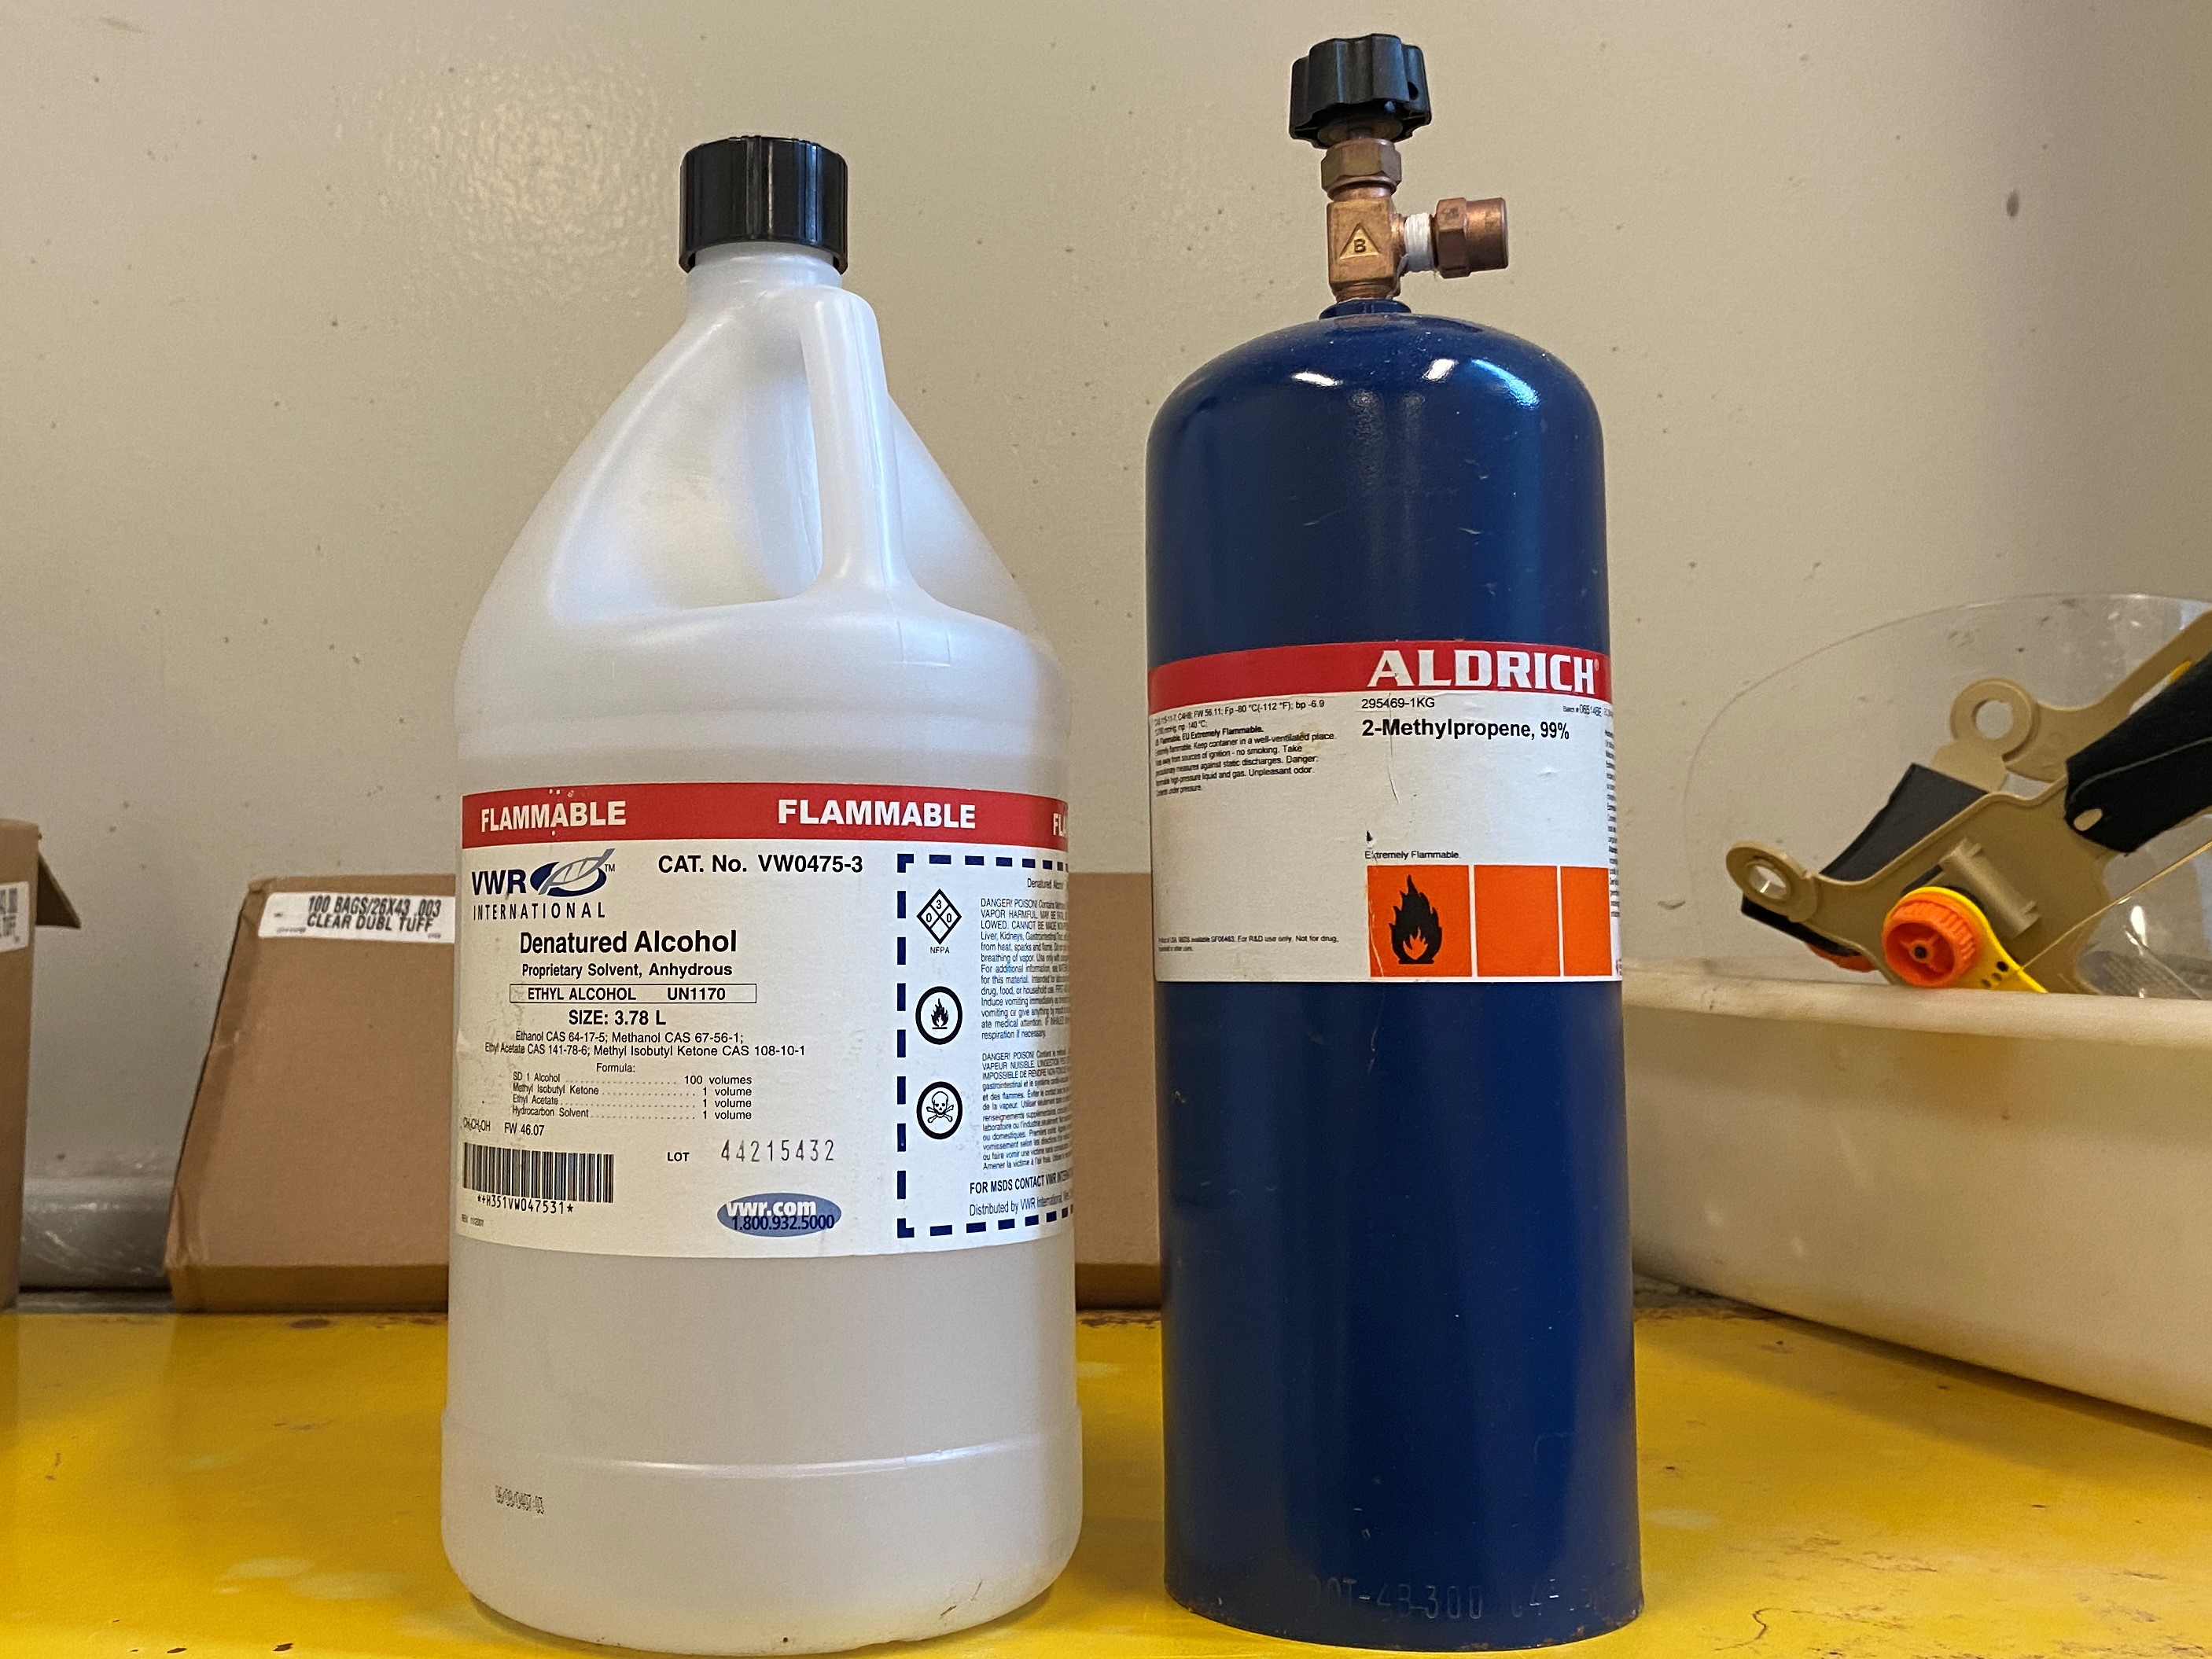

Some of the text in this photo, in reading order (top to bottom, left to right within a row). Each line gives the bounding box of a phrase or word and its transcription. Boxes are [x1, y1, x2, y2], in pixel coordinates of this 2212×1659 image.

[1354, 239, 1366, 253] B
[1367, 649, 1595, 695] ALDRICH
[1296, 701, 1306, 710] bp
[1361, 697, 1435, 708] 295469-1KG
[1191, 726, 1264, 739] Extremely Flammable.
[1362, 718, 1570, 740] 2-Methylpropene, 99%
[1194, 741, 1208, 750] Keep
[1254, 733, 1310, 744] well-ventilated
[1200, 761, 1221, 771] against
[1249, 767, 1292, 777] Unpleasant
[480, 800, 627, 833] FLAMMABLE
[778, 799, 976, 830] FLAMMABLE
[658, 855, 863, 873] CAT. No. VW0475-3
[472, 869, 527, 896] VWR
[307, 895, 331, 914] 100
[334, 896, 410, 916] BAGS/26X43
[936, 899, 942, 909] 3
[981, 899, 1013, 907] DANGER!
[473, 902, 605, 921] INTERNATIONAL
[926, 913, 951, 923] 0 0
[981, 910, 1006, 918] VAPOR
[307, 912, 434, 932] CLEAR DUBL TUFF
[1011, 921, 1036, 929] CANNOT
[520, 930, 737, 954] Denatured Alcohol
[981, 942, 996, 951] from
[1014, 943, 1032, 953] sparks
[981, 954, 1010, 964] breathing
[522, 962, 733, 979] Proprietary Solvent, Anhydrous
[981, 964, 1023, 973] For additional
[981, 975, 1003, 984] for this
[528, 988, 726, 1001] ETHYL ALCOHOL UN1170
[981, 997, 1028, 1007] Induce vomiting
[569, 1010, 666, 1025] SIZE: 3.78 L
[981, 1008, 1008, 1019] vomiting
[1018, 1008, 1029, 1017] give
[981, 1019, 1018, 1028] ate medical
[516, 1030, 744, 1044] Ethanol CAS 64-17-5; Methanol CAS 67-56-1;
[981, 1030, 1014, 1041] respiration
[500, 1043, 525, 1054] Acetate
[528, 1044, 545, 1055] CAS
[548, 1044, 590, 1057] 141-78-6;
[594, 1045, 627, 1058] Methyl
[631, 1045, 673, 1059] Isobutyl
[677, 1046, 718, 1057] Ketone
[722, 1045, 749, 1057] CAS
[754, 1045, 805, 1057] 108-10-1
[596, 1062, 635, 1073] Formula:
[513, 1072, 753, 1085] SD 1 Alcohol 100 volumes
[982, 1071, 1018, 1080] IMPOSSIBLE
[513, 1083, 753, 1096] Methyl Isobutyl Ketone 1 volume
[532, 1095, 558, 1105] Acetate
[702, 1098, 707, 1108] 1
[714, 1098, 752, 1108] volume
[513, 1105, 752, 1120] Hydrocarbon Solvent 1 volume
[982, 1113, 1025, 1123] renseignements
[504, 1122, 517, 1135] FW
[521, 1124, 545, 1136] 46.07
[982, 1123, 1011, 1131] laboratoire
[667, 1139, 834, 1162] LOT 44215432
[982, 1142, 1018, 1150] vomissement
[970, 1181, 988, 1194] FOR
[991, 1179, 1013, 1192] MSDS
[1015, 1175, 1044, 1190] CONTACT
[726, 1201, 816, 1216] vwr.com
[970, 1197, 1036, 1216] Distributed by VWR
[732, 1215, 835, 1230] 1.800.932.5000
